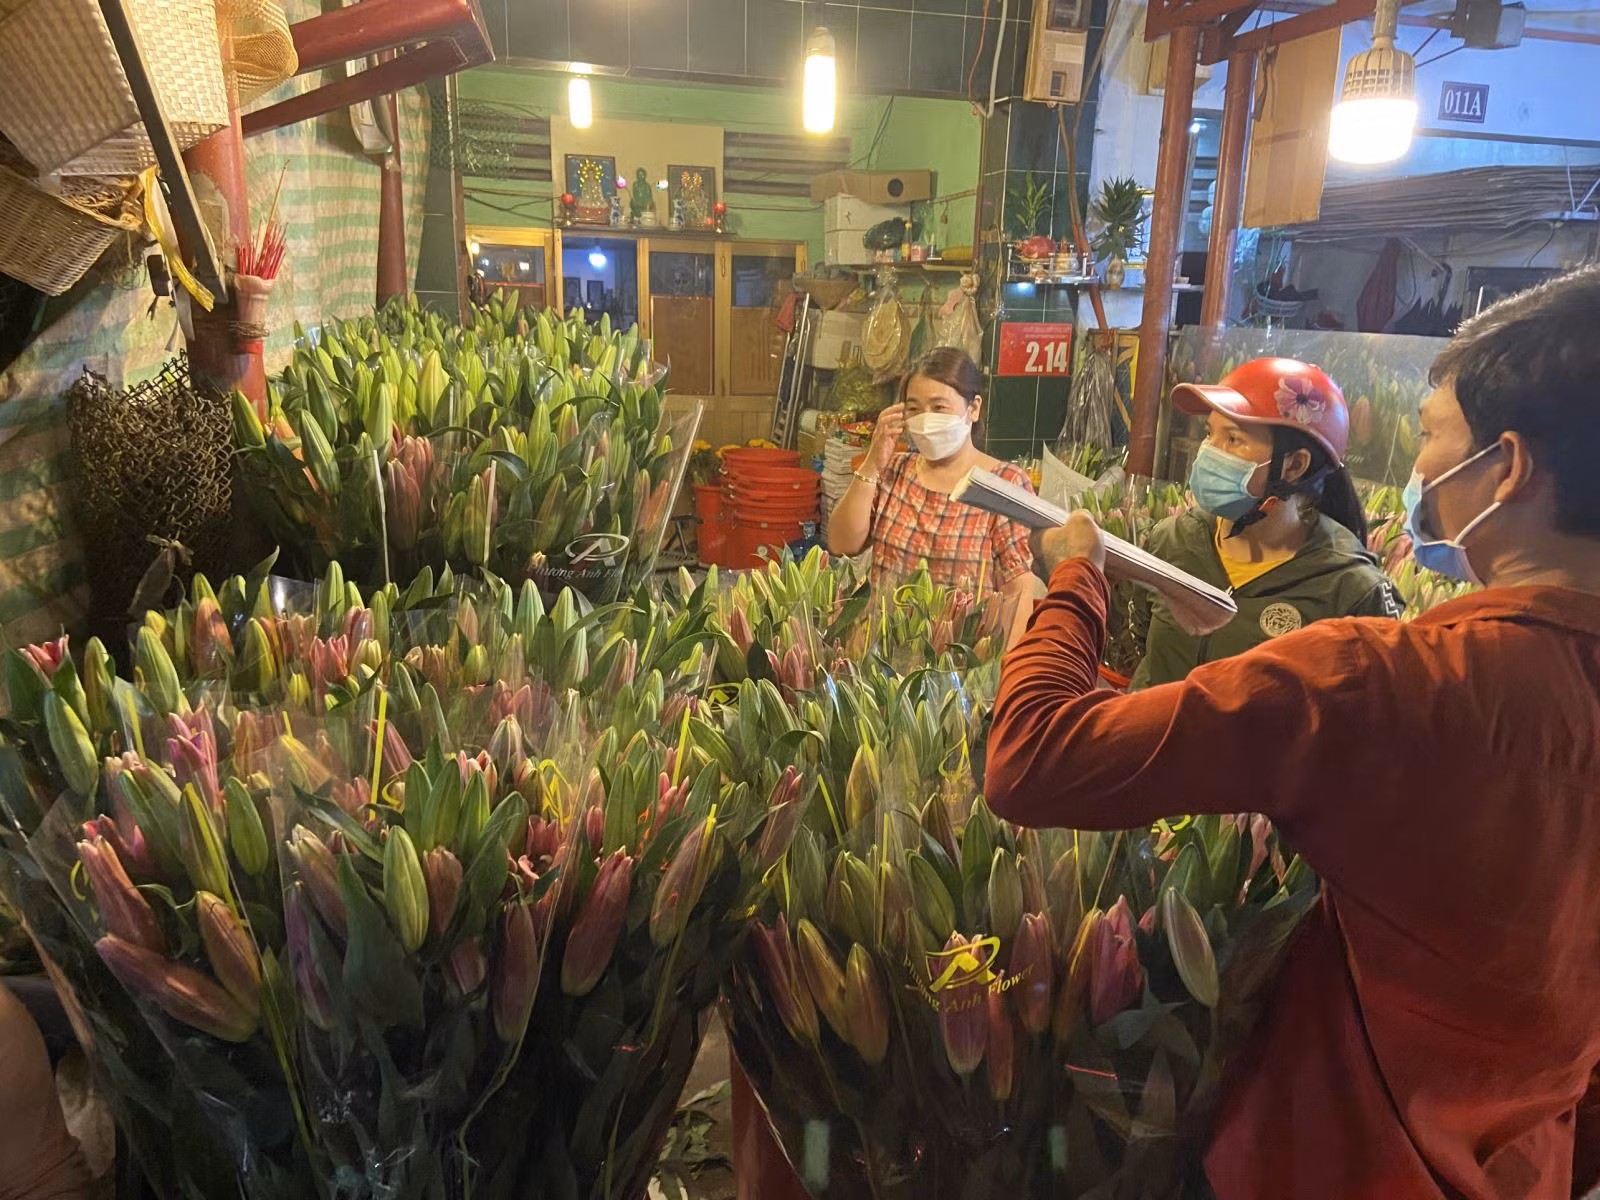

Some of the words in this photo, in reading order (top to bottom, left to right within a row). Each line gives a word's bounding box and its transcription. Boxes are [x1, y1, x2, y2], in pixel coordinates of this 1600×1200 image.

[1445, 90, 1481, 116] 011A
[1025, 342, 1068, 372] 2.14
[988, 963, 1034, 996] Flower
